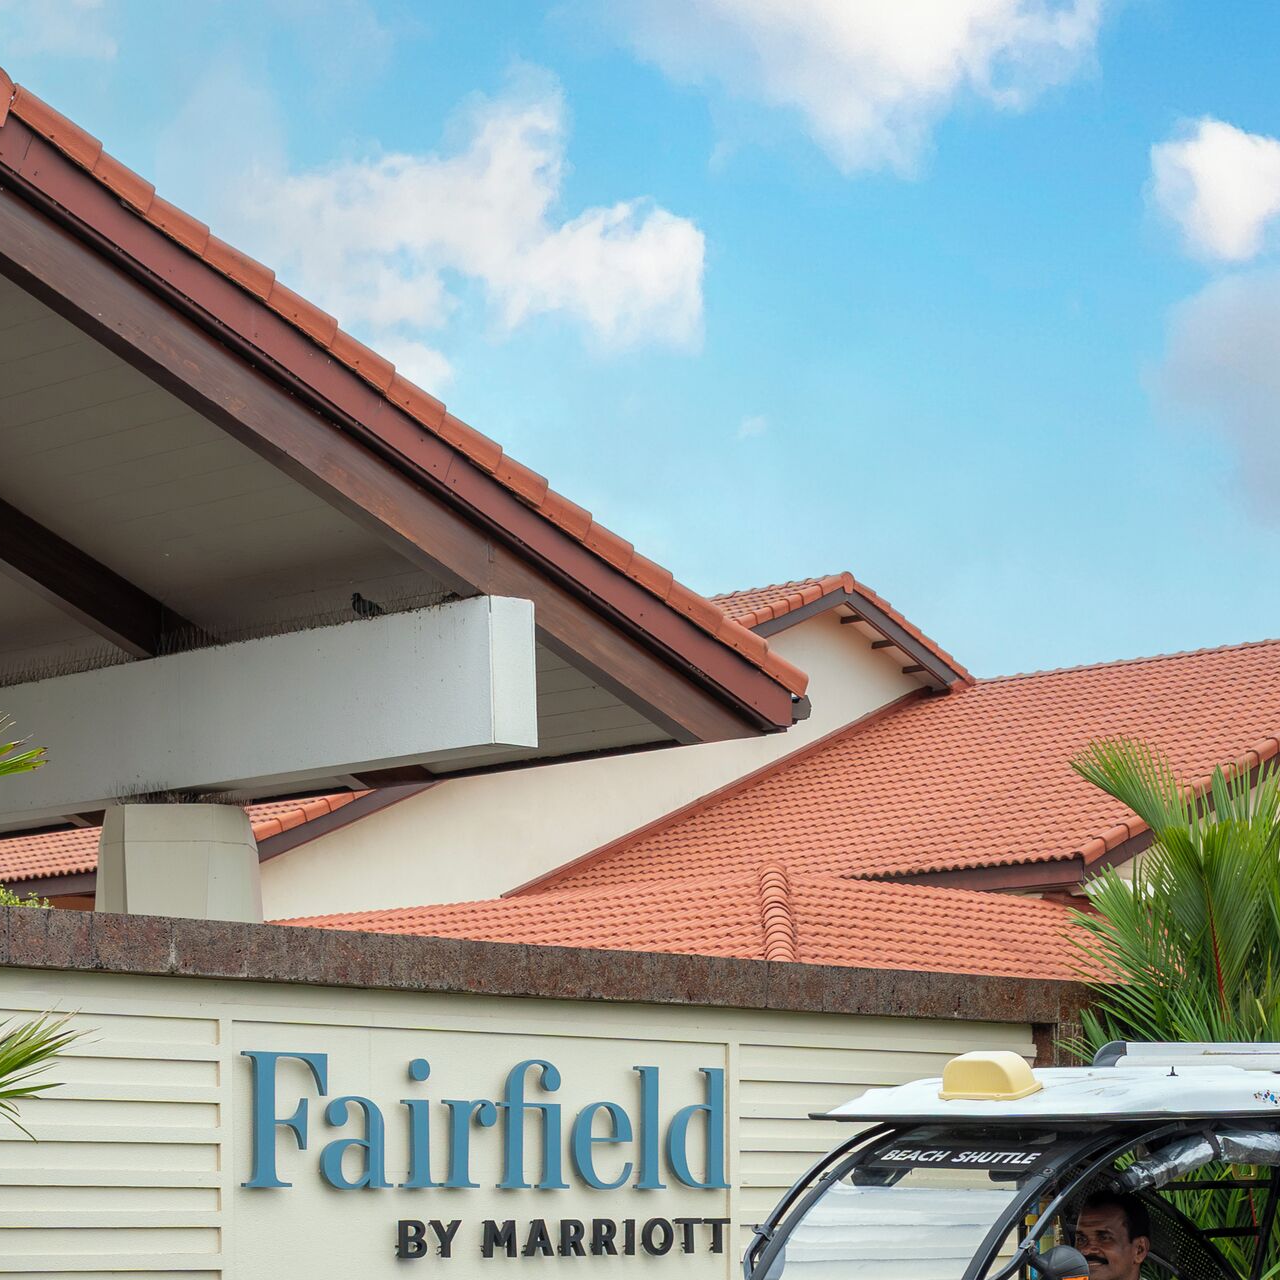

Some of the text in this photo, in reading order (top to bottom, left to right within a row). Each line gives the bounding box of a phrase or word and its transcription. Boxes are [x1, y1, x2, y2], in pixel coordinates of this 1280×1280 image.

[241, 1050, 731, 1191] Fairfield
[880, 1149, 1042, 1165] BEACH SHUTTLE
[397, 1217, 731, 1259] BY MARRIOTT
